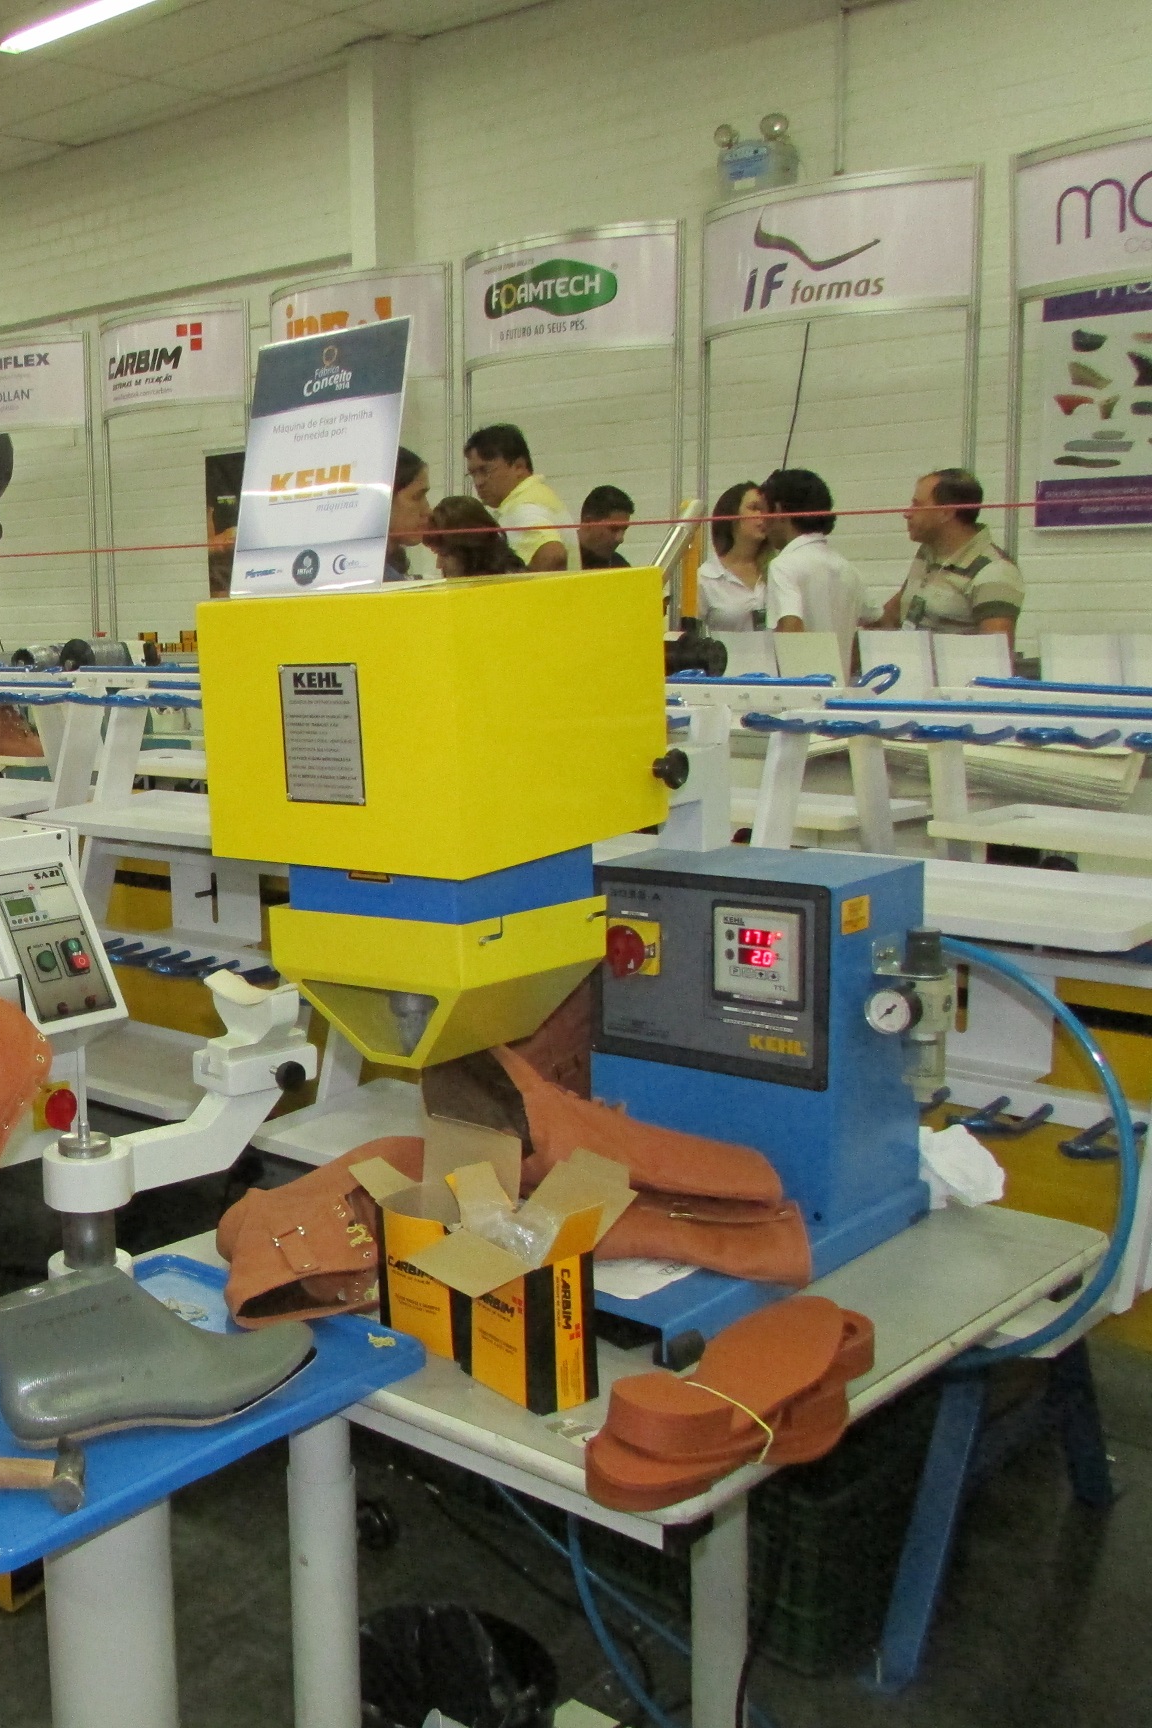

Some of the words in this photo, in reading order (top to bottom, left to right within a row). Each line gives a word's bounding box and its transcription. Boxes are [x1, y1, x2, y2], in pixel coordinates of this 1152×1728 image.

[491, 273, 601, 310] FOAMTECH
[790, 276, 885, 305] formas
[505, 325, 532, 340] FUTURO
[534, 323, 545, 335] AO
[548, 319, 567, 333] SEUS
[108, 345, 183, 380] CARBIM
[303, 369, 353, 397] Conceito
[273, 423, 305, 434] Máquina
[308, 419, 318, 429] de
[319, 416, 336, 427] Fixar
[339, 409, 373, 423] Palmilha
[294, 429, 328, 442] fornecida
[269, 464, 357, 503] KEHL
[293, 671, 342, 688] KEHL
[34, 869, 60, 880] SAZI
[723, 915, 745, 924] KEHL
[749, 1034, 807, 1057] KEHL
[561, 1268, 573, 1330] CARBIM
